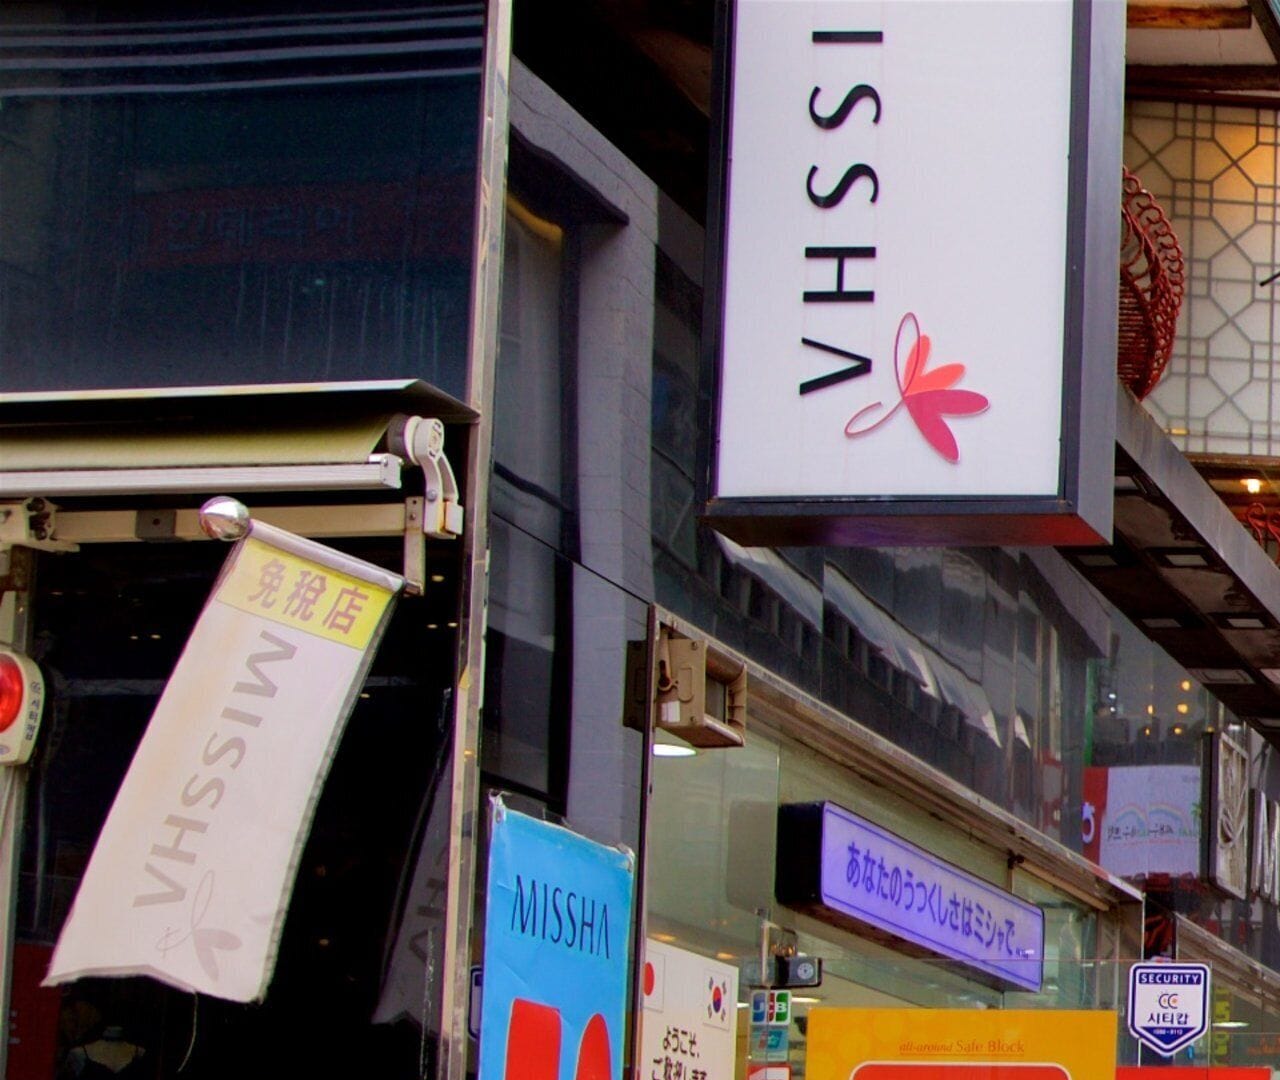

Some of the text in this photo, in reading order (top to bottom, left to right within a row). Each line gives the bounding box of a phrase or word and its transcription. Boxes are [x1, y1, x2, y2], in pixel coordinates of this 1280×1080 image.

[132, 629, 300, 909] MISSHA
[509, 873, 613, 960] MISSHA
[1140, 974, 1200, 984] SECURITY
